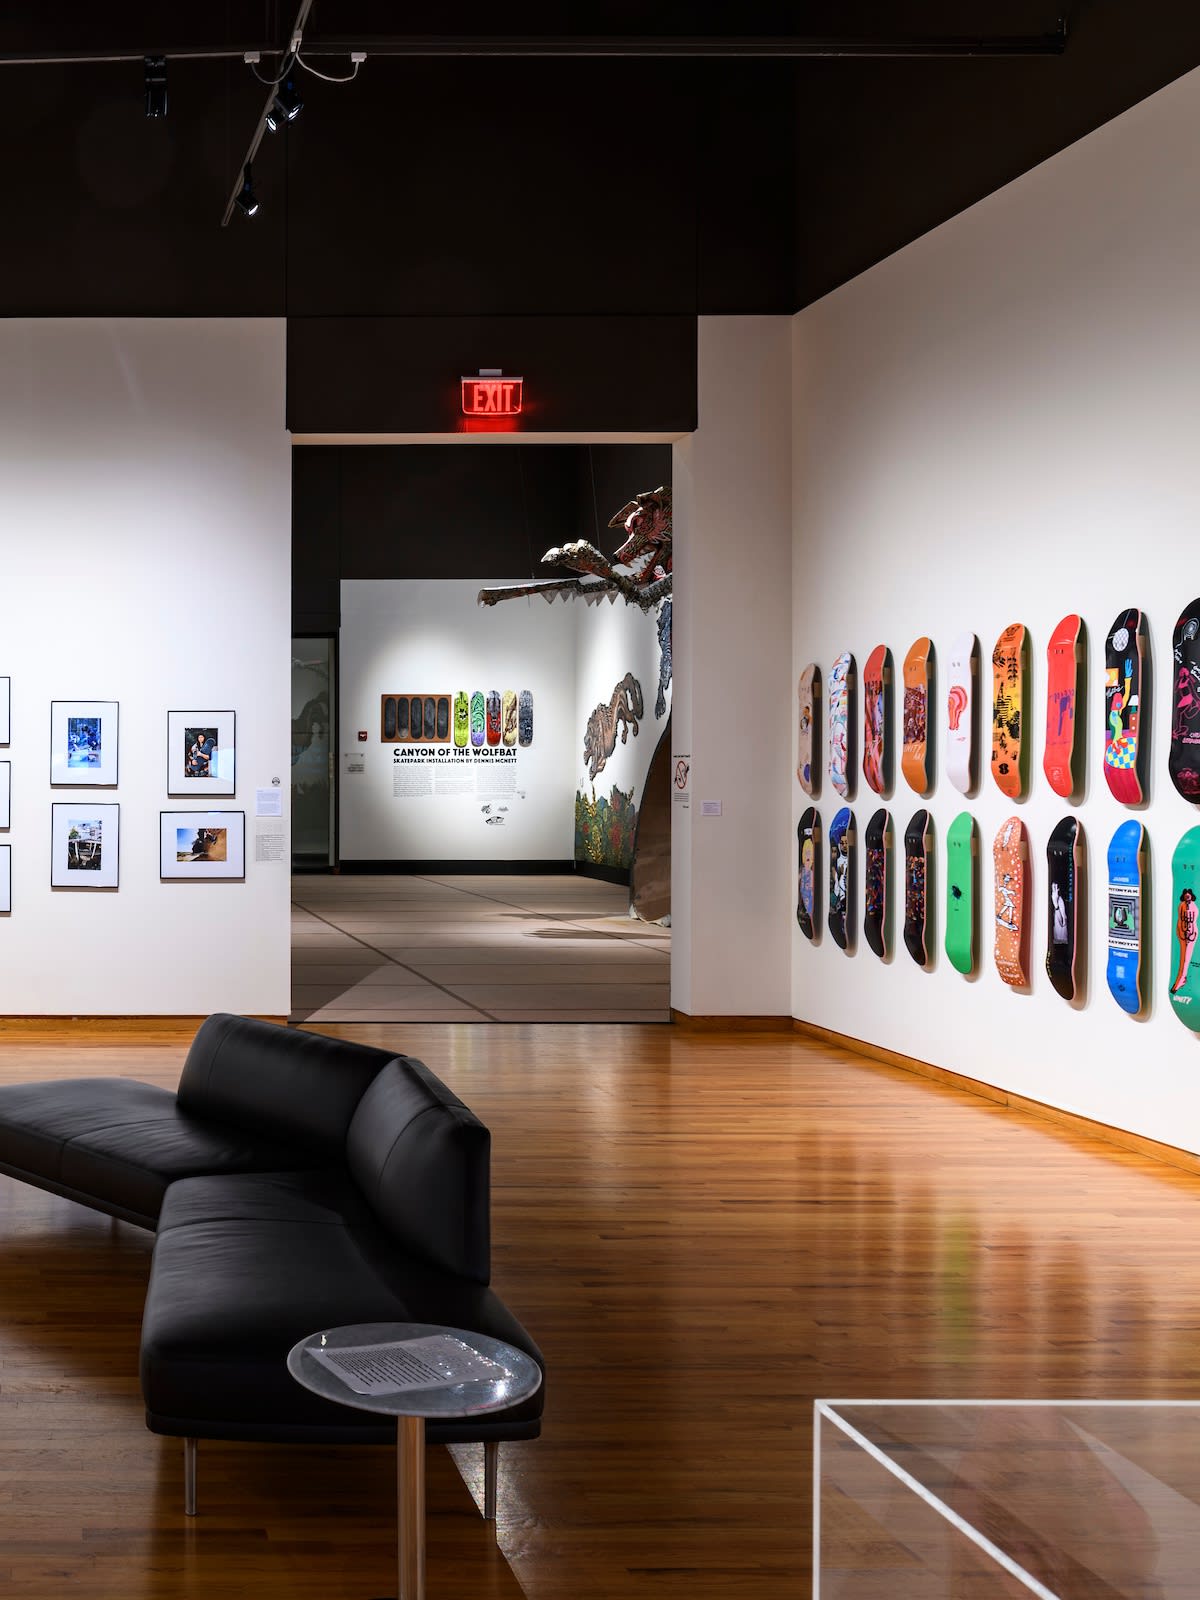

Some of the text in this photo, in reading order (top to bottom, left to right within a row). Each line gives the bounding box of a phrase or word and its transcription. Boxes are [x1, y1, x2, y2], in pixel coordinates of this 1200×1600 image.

[473, 384, 514, 412] EXIT
[393, 748, 517, 757] CANYON OF THE WOLFBAT
